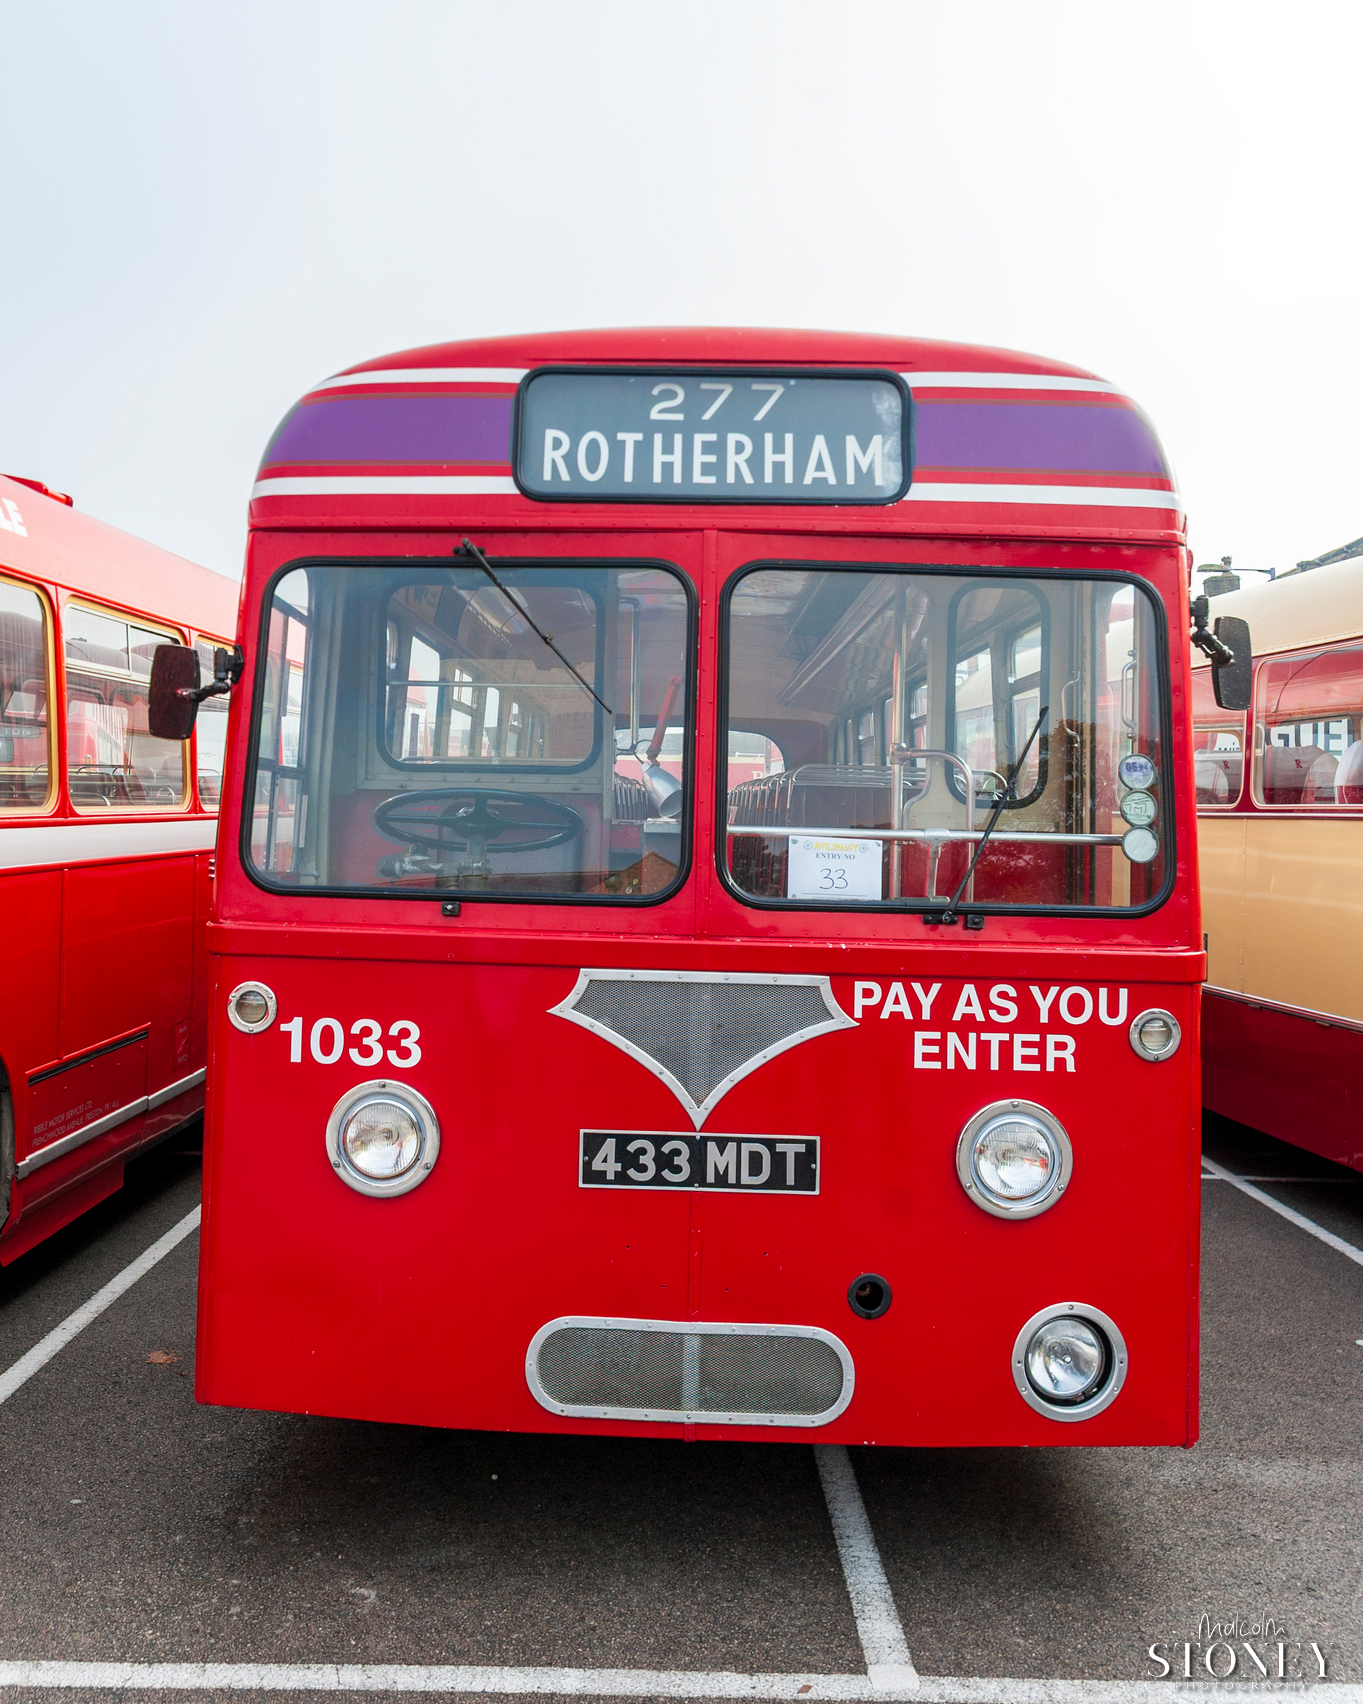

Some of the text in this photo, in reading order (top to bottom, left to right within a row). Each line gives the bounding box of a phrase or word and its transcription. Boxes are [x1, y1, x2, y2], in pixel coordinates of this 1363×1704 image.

[649, 382, 786, 422] 277
[542, 428, 884, 486] ROTHERHAM
[832, 843, 858, 851] VALLEY
[819, 868, 848, 889] 33
[853, 980, 1128, 1026] PAY AS YOU
[279, 1016, 422, 1069] 1033
[913, 1030, 1077, 1072] ENTER
[33, 1121, 48, 1134] RIBBLE
[48, 1114, 65, 1127] MOTOR
[65, 1103, 85, 1120] SERVICES
[66, 1115, 84, 1132] AVENUE
[591, 1137, 806, 1186] 433 MDT
